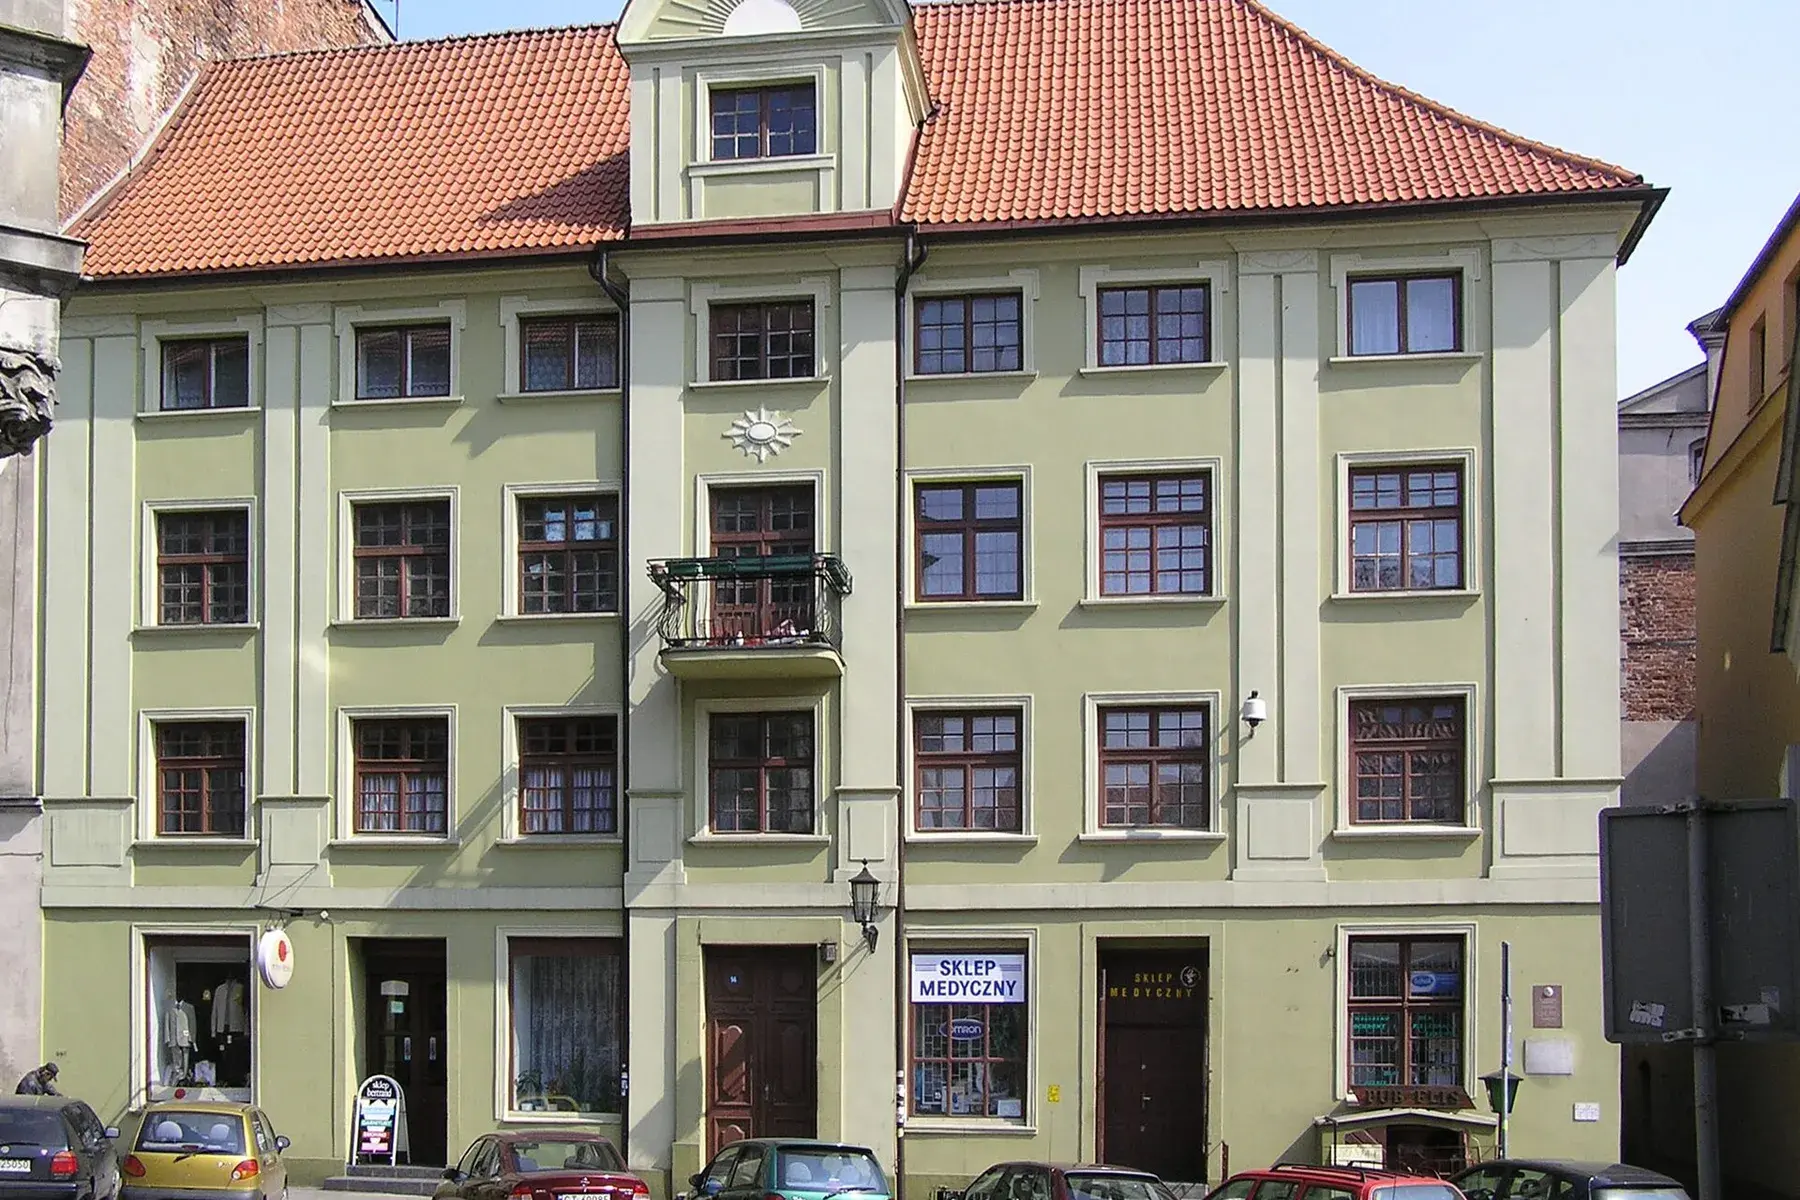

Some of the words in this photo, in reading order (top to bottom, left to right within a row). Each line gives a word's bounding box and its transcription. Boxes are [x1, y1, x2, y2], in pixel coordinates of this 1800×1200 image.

[940, 960, 996, 976] SKLEP
[1134, 973, 1172, 983] SKLEP
[920, 980, 1017, 996] MEDYCZNY
[1110, 987, 1192, 997] MEDYCZNY
[1367, 1088, 1404, 1105] PUB
